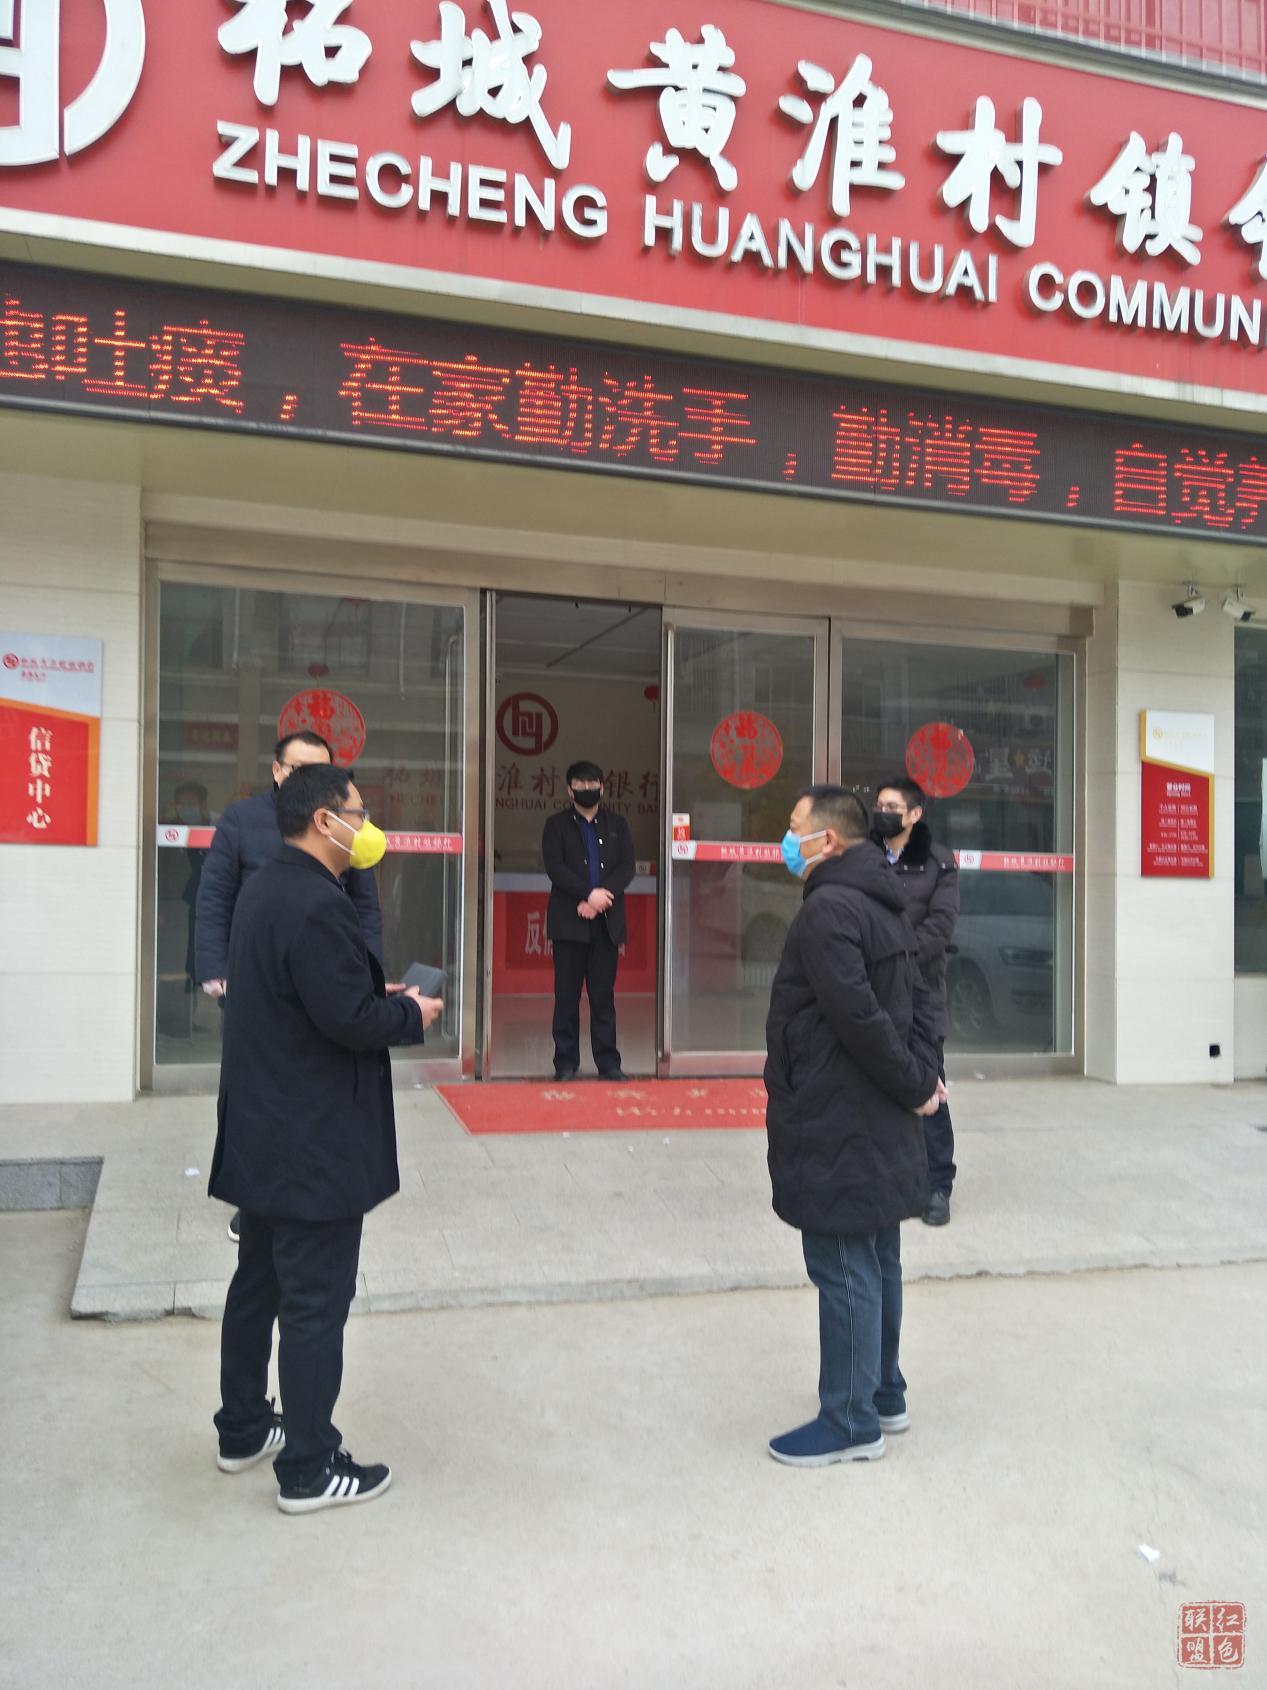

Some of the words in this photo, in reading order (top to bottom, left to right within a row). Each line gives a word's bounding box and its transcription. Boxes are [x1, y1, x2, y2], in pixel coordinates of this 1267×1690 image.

[213, 120, 608, 238] ZHECHENG
[642, 195, 998, 303] HUANGHUAI
[1028, 262, 1267, 346] COMMUN
[218, 0, 1267, 279] 柘城黄淮村镇
[26, 726, 53, 829] 信贷中心
